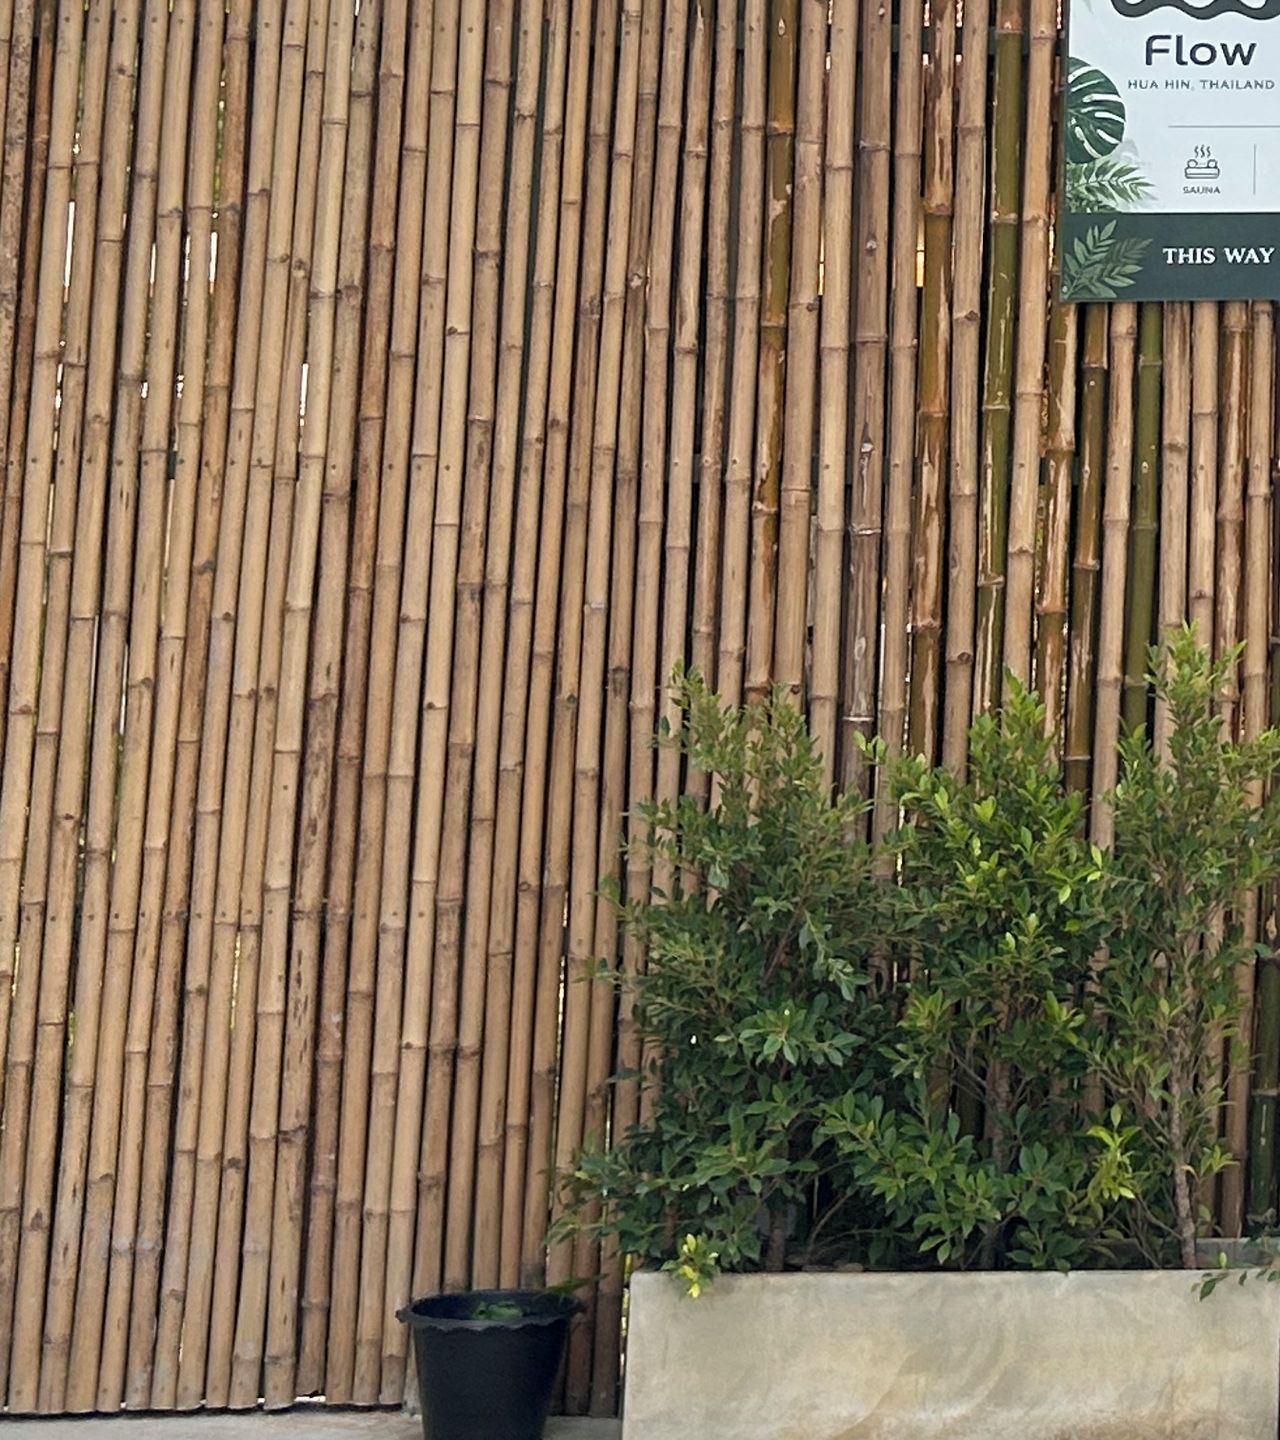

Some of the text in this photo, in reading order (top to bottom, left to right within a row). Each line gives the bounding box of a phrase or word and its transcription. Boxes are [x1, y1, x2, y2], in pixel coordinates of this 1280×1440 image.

[1144, 34, 1258, 67] Flow
[1127, 79, 1159, 90] HUA
[1199, 79, 1275, 90] THAILAND
[1182, 185, 1221, 195] SAUNA
[1162, 246, 1216, 265] THIS
[1224, 246, 1275, 265] WAY
